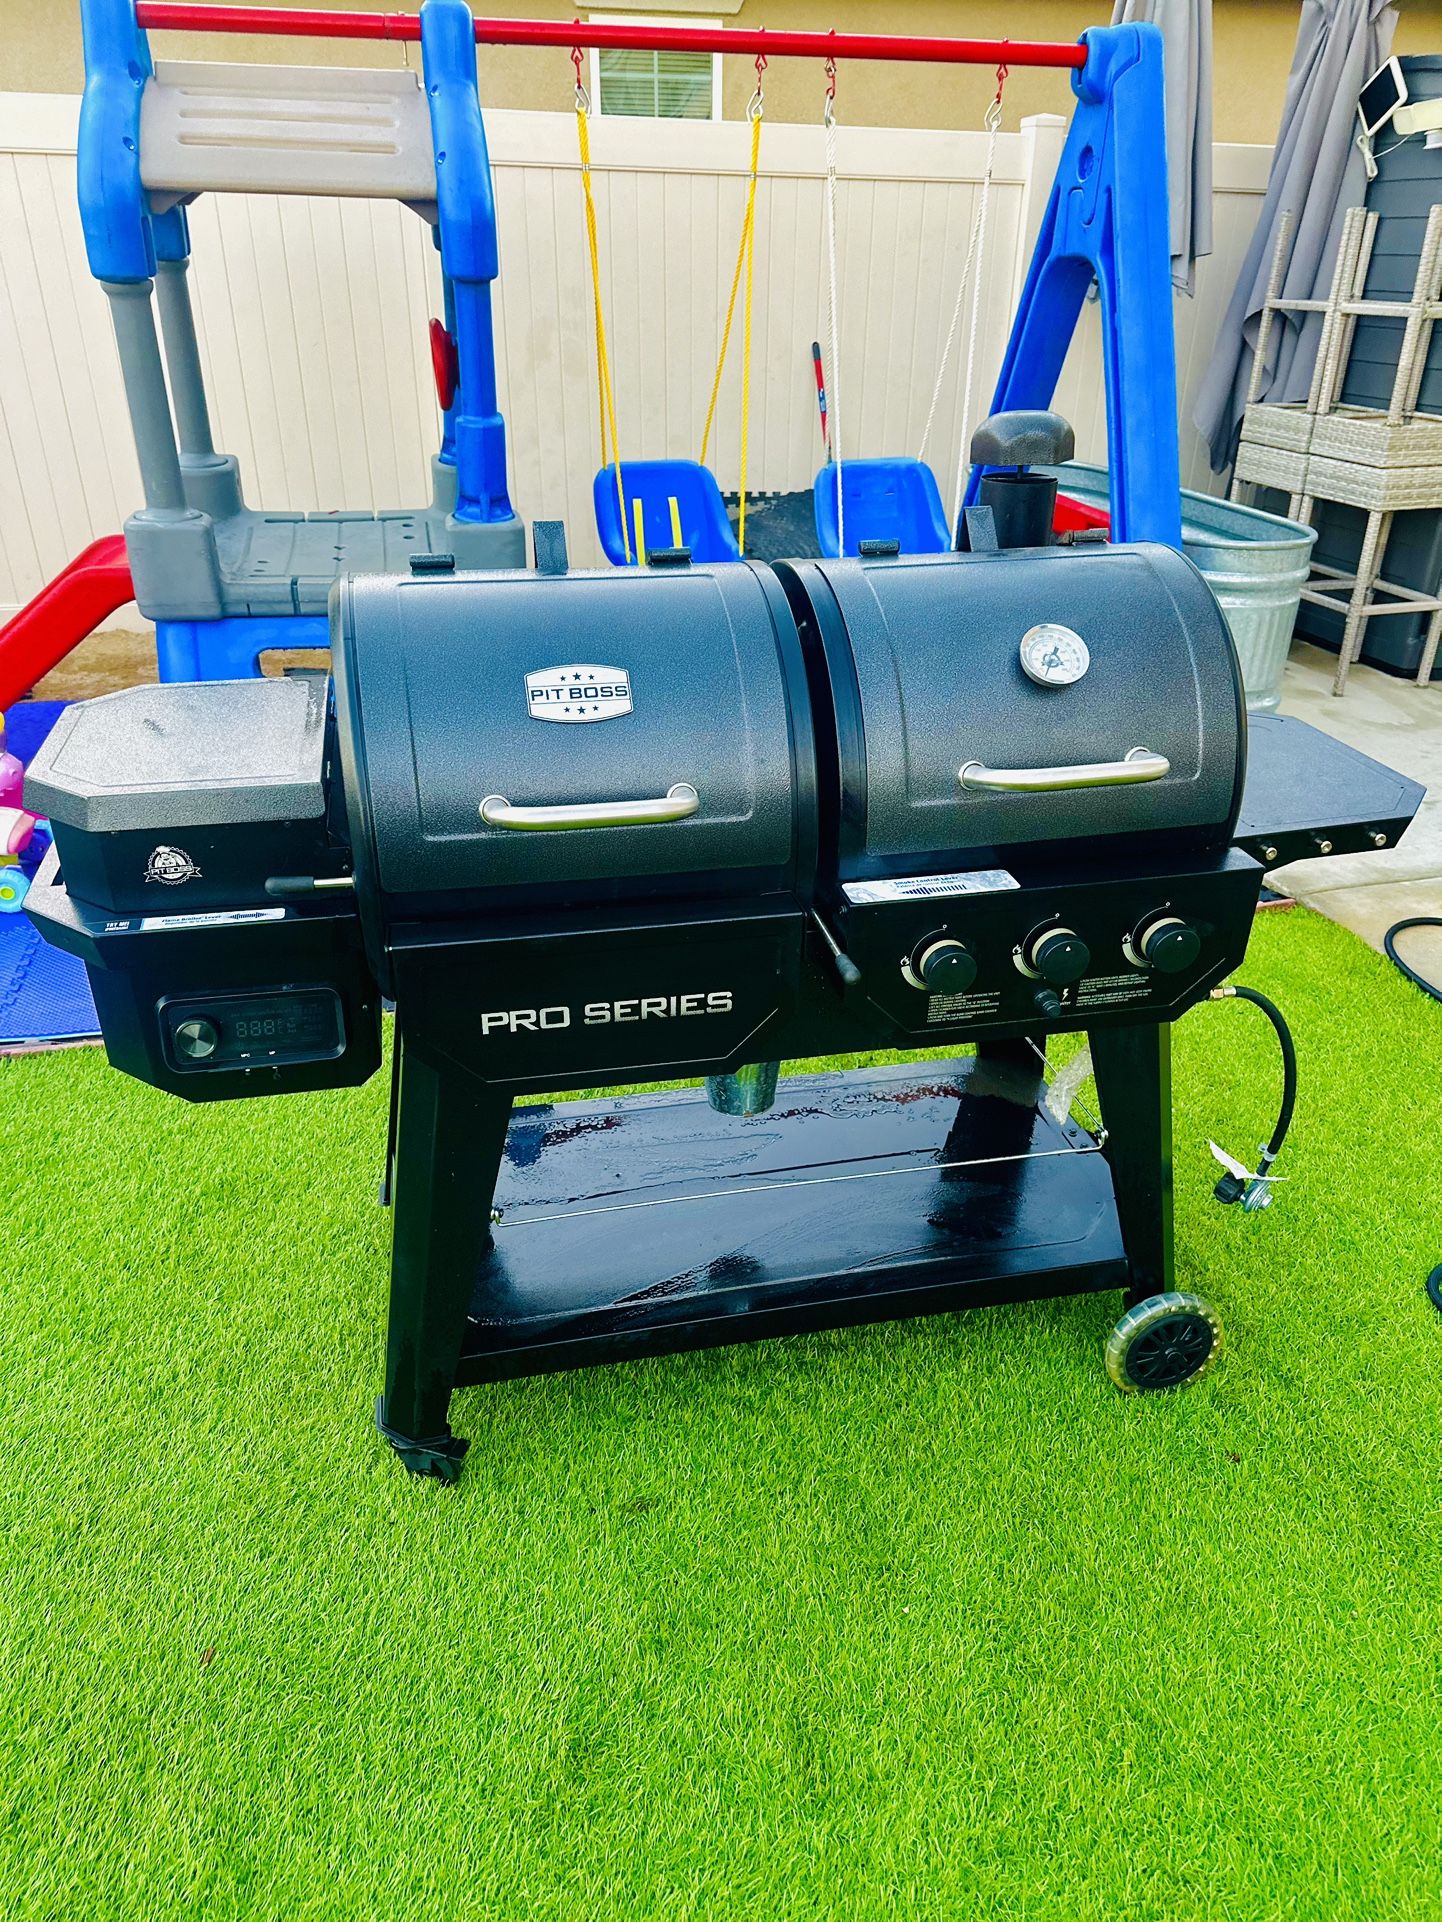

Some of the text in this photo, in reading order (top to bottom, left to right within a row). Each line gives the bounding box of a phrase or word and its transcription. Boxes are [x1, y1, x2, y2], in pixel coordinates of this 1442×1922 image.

[530, 685, 628, 701] PIT BOSS
[481, 991, 733, 1035] PRO SERIES
